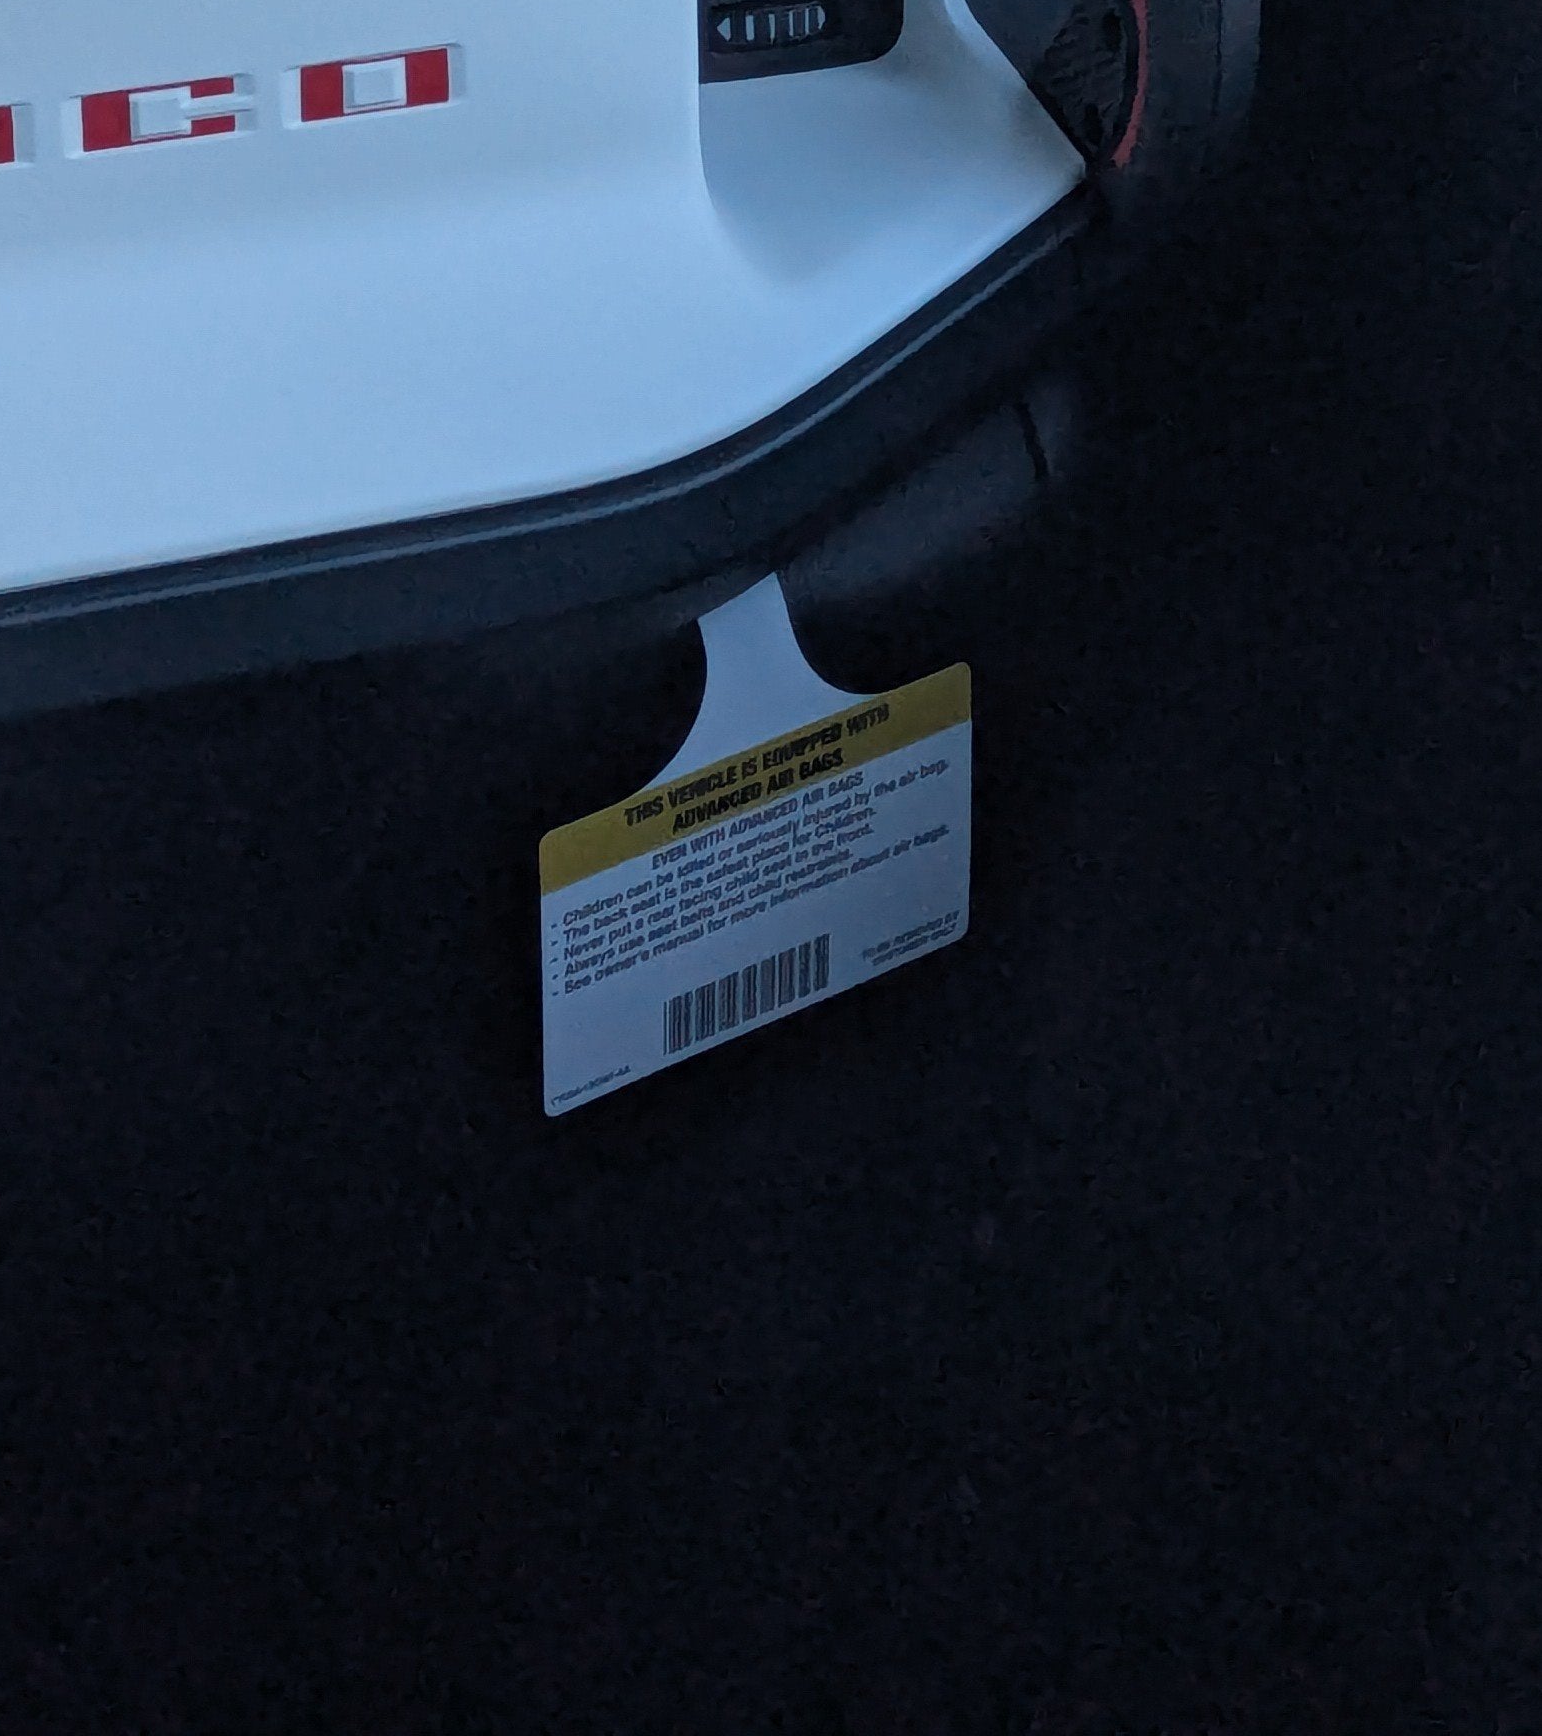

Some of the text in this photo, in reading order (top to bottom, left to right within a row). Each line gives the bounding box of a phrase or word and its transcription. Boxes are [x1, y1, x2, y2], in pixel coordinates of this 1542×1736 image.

[624, 702, 888, 828] THIS VEHICLE IS EQUIPPED WITH
[653, 769, 863, 870] EVEN WITH ADVANCED AIR BAGS
[672, 746, 842, 836] ADVANCED AIR BAGS
[563, 889, 622, 927] Children
[627, 877, 651, 901] can
[655, 868, 673, 889] be
[677, 851, 714, 880] killed
[718, 843, 733, 863] or
[737, 817, 796, 859] seriously
[802, 795, 849, 830] injured
[854, 786, 870, 809] by
[874, 776, 895, 798] the
[899, 767, 917, 788] air
[565, 919, 589, 942] The
[593, 903, 627, 931] back
[630, 889, 661, 915] seat
[665, 882, 677, 901] is
[681, 872, 703, 894] the
[706, 853, 749, 884] safest
[752, 837, 788, 867] place
[565, 931, 604, 961] Never
[608, 920, 630, 945] put
[634, 915, 642, 931] a
[647, 902, 674, 926] rear
[678, 883, 721, 916] facing
[725, 867, 758, 893] child
[762, 854, 791, 878] seat
[795, 847, 807, 864] in
[810, 837, 832, 858] the
[565, 971, 589, 994] See
[594, 946, 649, 982] owner's
[653, 923, 703, 957] manual
[708, 914, 726, 935] for
[730, 897, 766, 925] more
[770, 863, 847, 908] information
[851, 845, 889, 875] about
[893, 836, 911, 857] air
[565, 944, 614, 979] Always
[618, 932, 643, 954] use
[647, 918, 677, 942] seat
[681, 903, 714, 928] belts
[718, 891, 743, 913] and
[748, 876, 780, 900] child
